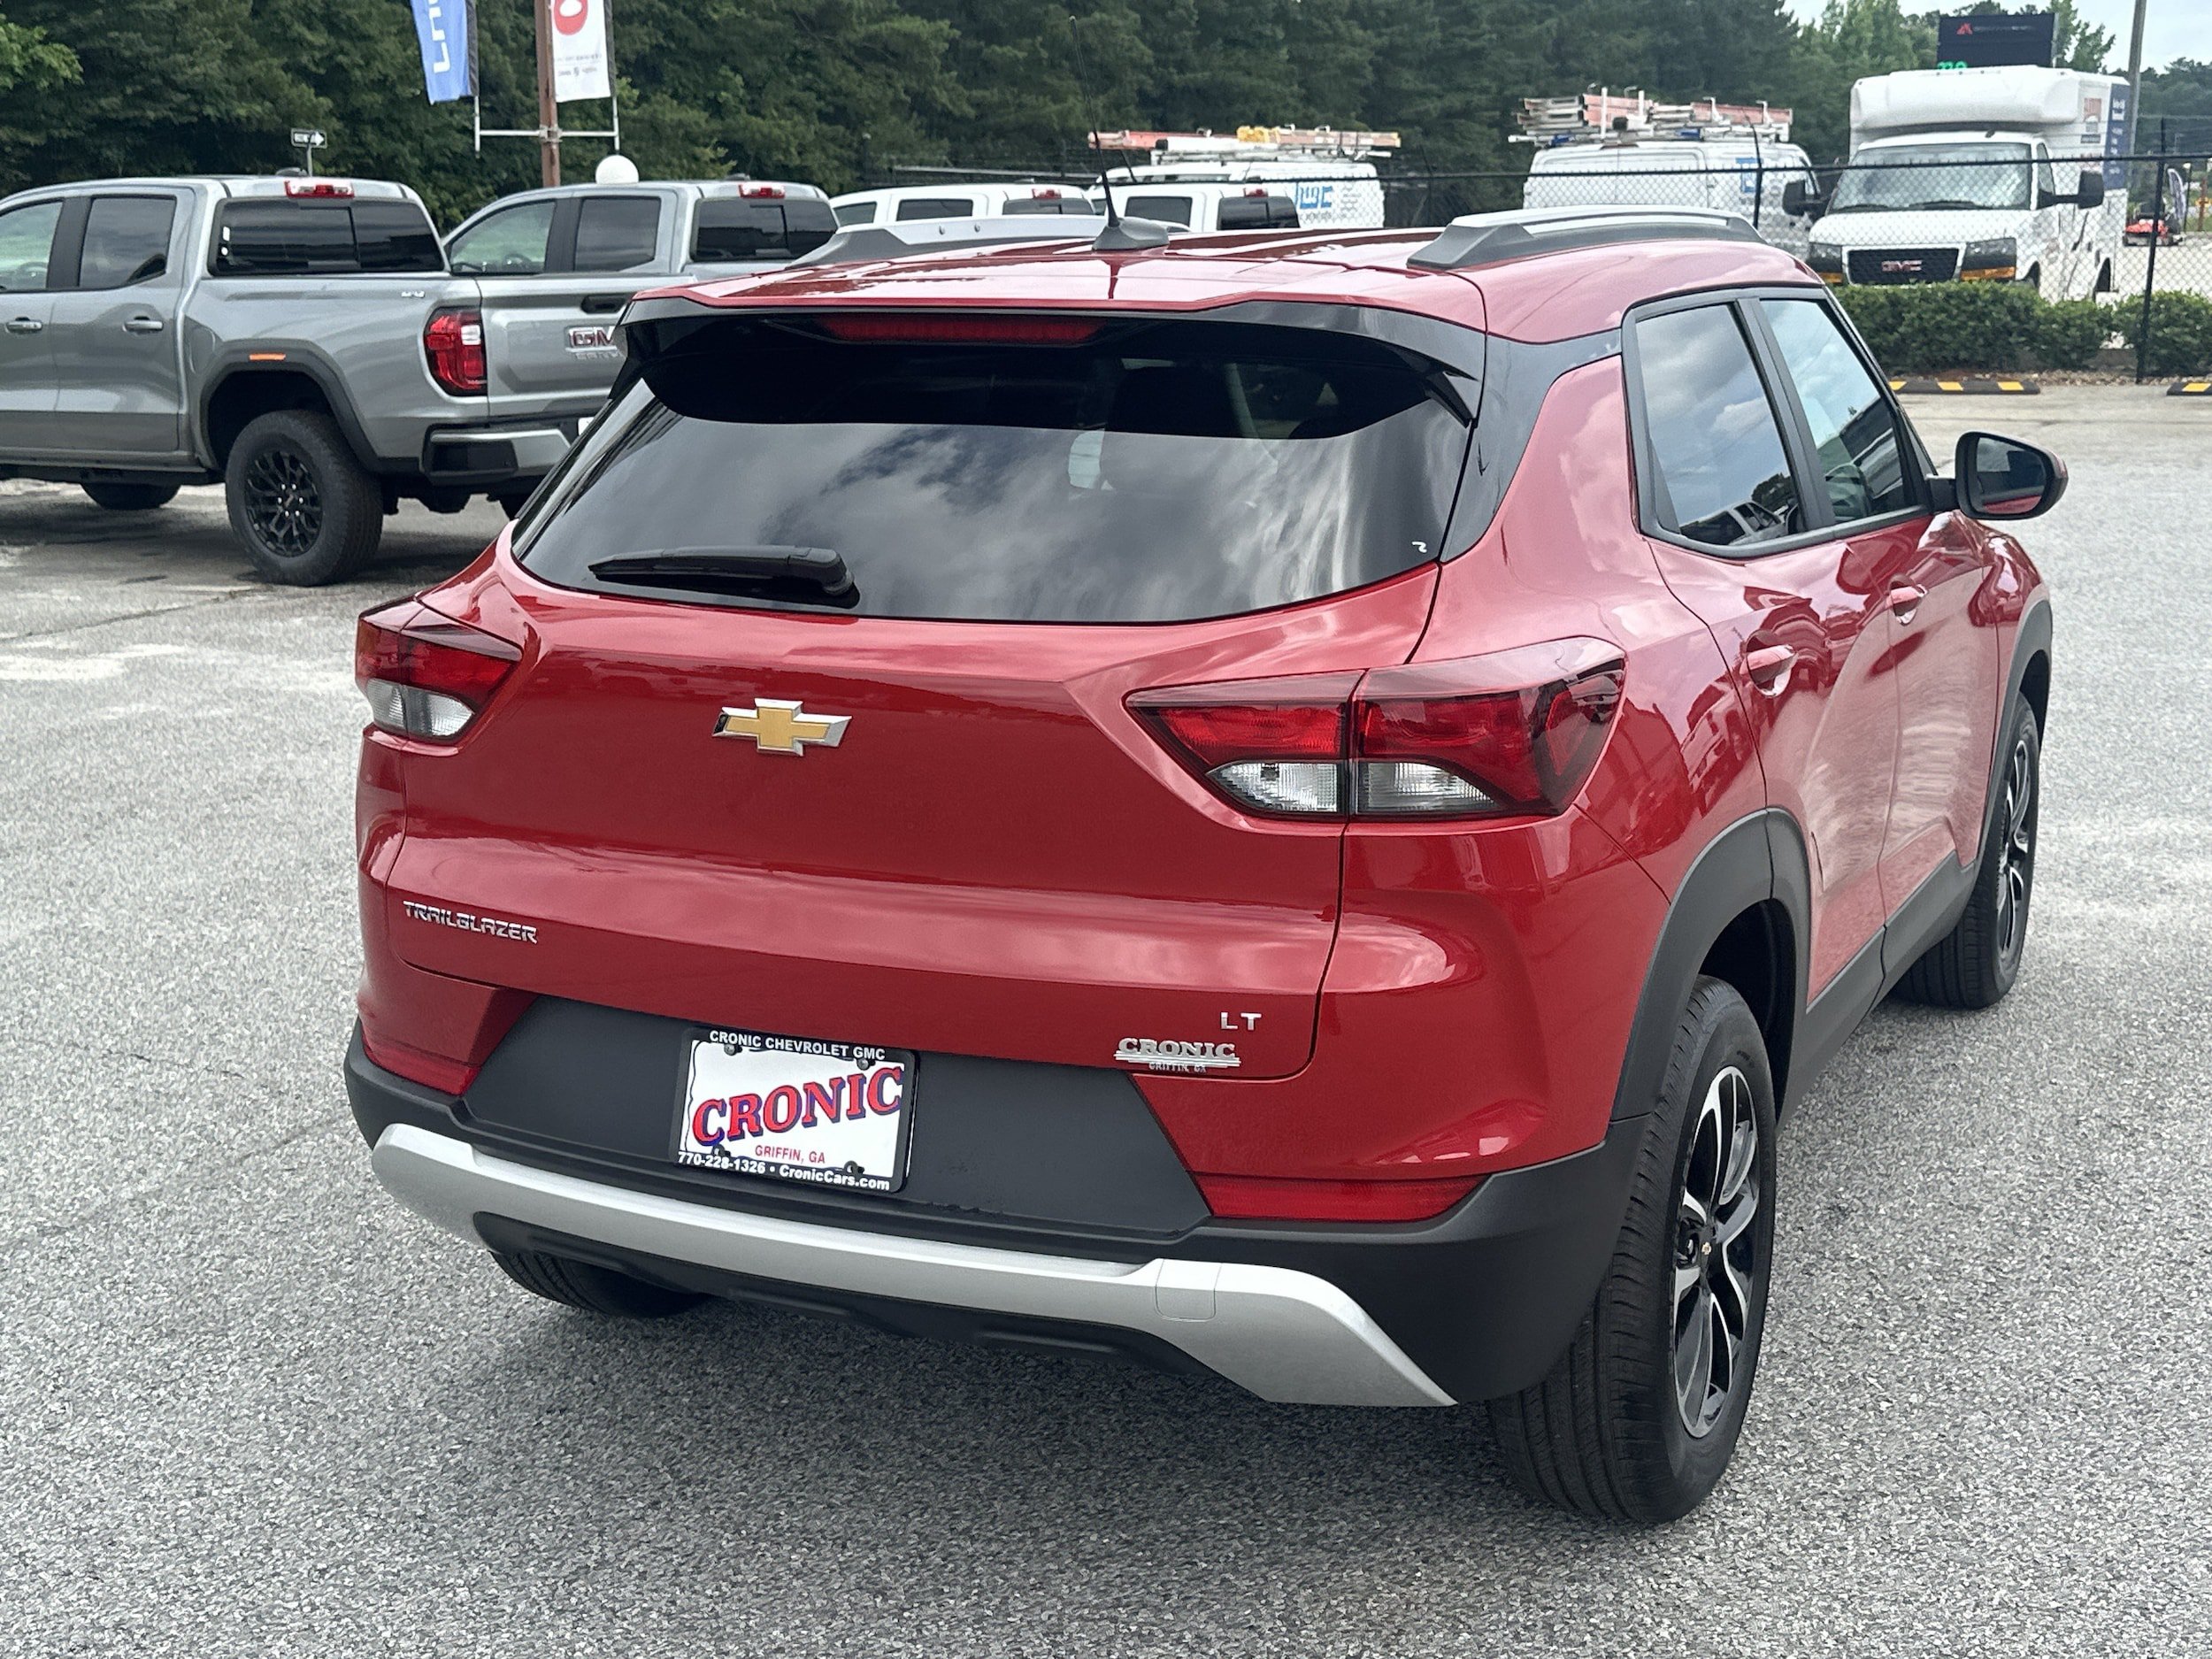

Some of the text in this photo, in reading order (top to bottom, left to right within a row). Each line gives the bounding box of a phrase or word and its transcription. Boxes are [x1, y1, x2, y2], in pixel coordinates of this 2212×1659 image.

[569, 326, 617, 348] GM
[403, 900, 538, 944] TRAILBLAZER
[1220, 1011, 1262, 1031] LT
[710, 1030, 886, 1060] CRONIC CHEVROLET GMC
[1118, 1037, 1236, 1059] CRONIC
[692, 1066, 904, 1147] CRONIC
[755, 1144, 826, 1164] GRIFFIN, GA
[678, 1150, 890, 1191] 770-228-1326 CronicCars.com
